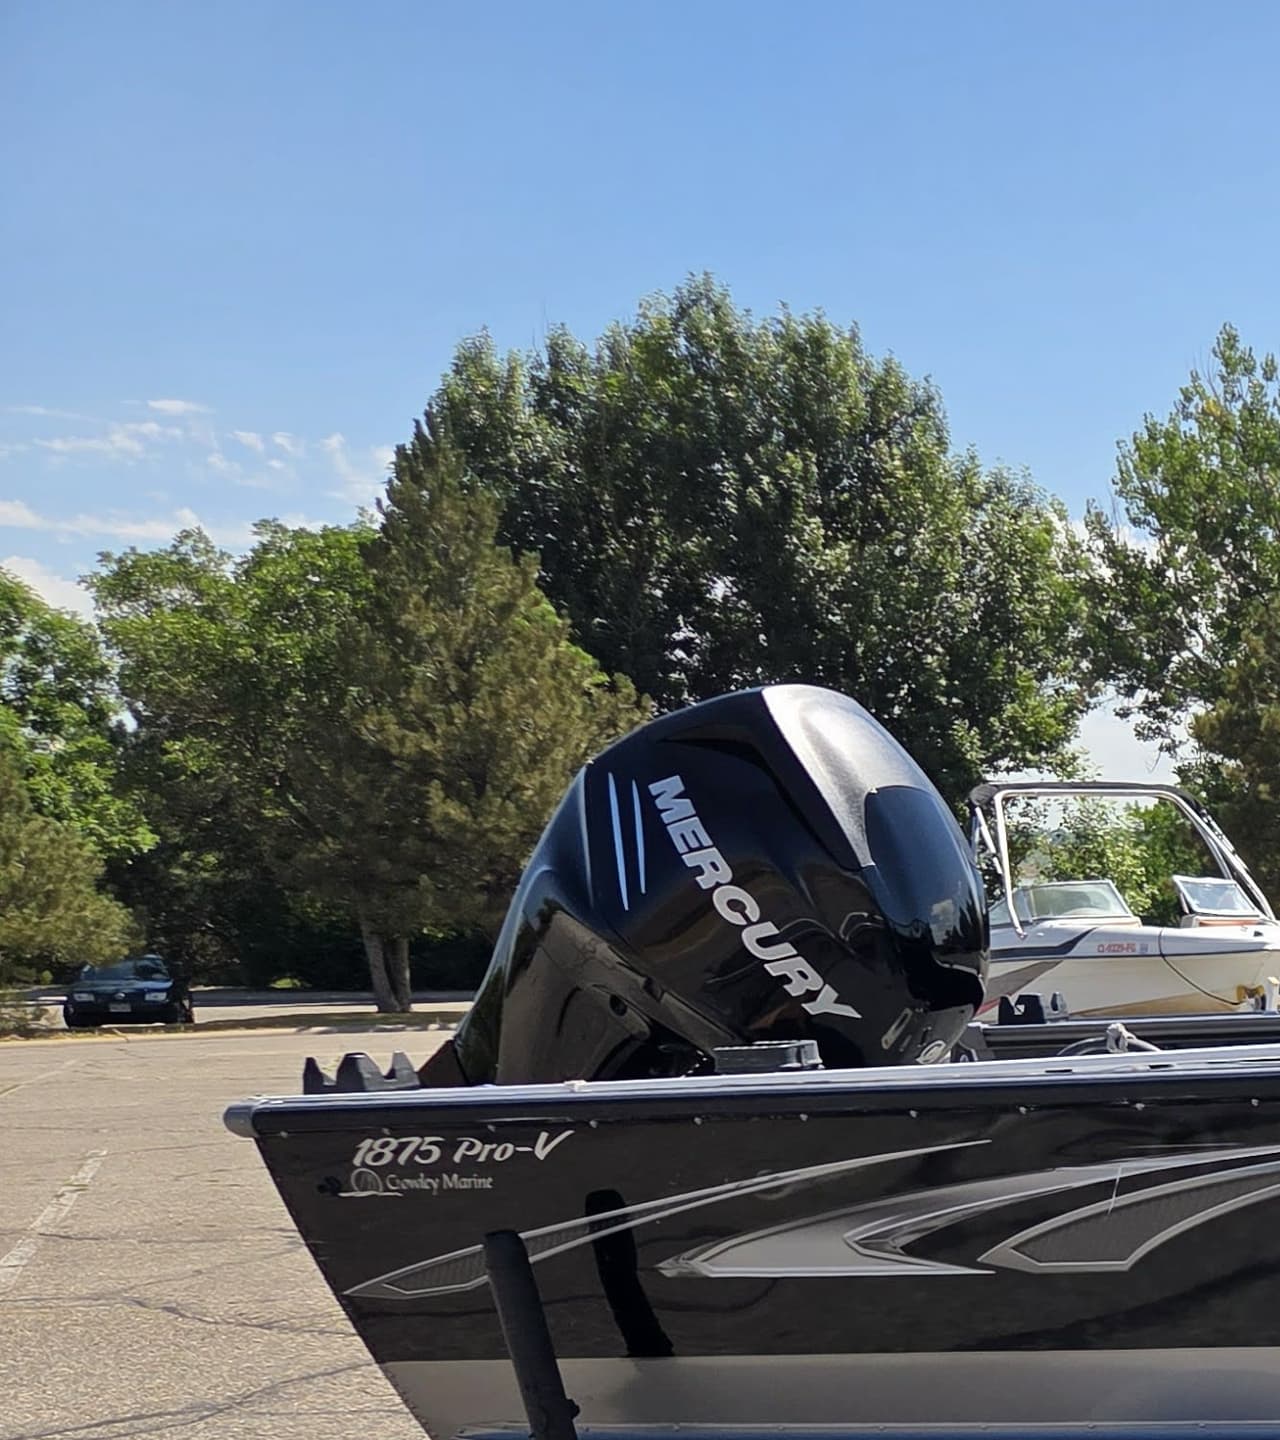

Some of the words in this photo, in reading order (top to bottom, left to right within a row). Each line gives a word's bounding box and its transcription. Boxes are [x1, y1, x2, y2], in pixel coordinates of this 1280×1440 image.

[647, 774, 863, 1019] MERCURY
[352, 1136, 445, 1167] 1875
[452, 1129, 576, 1163] Pro-V
[442, 1173, 494, 1190] Marine
